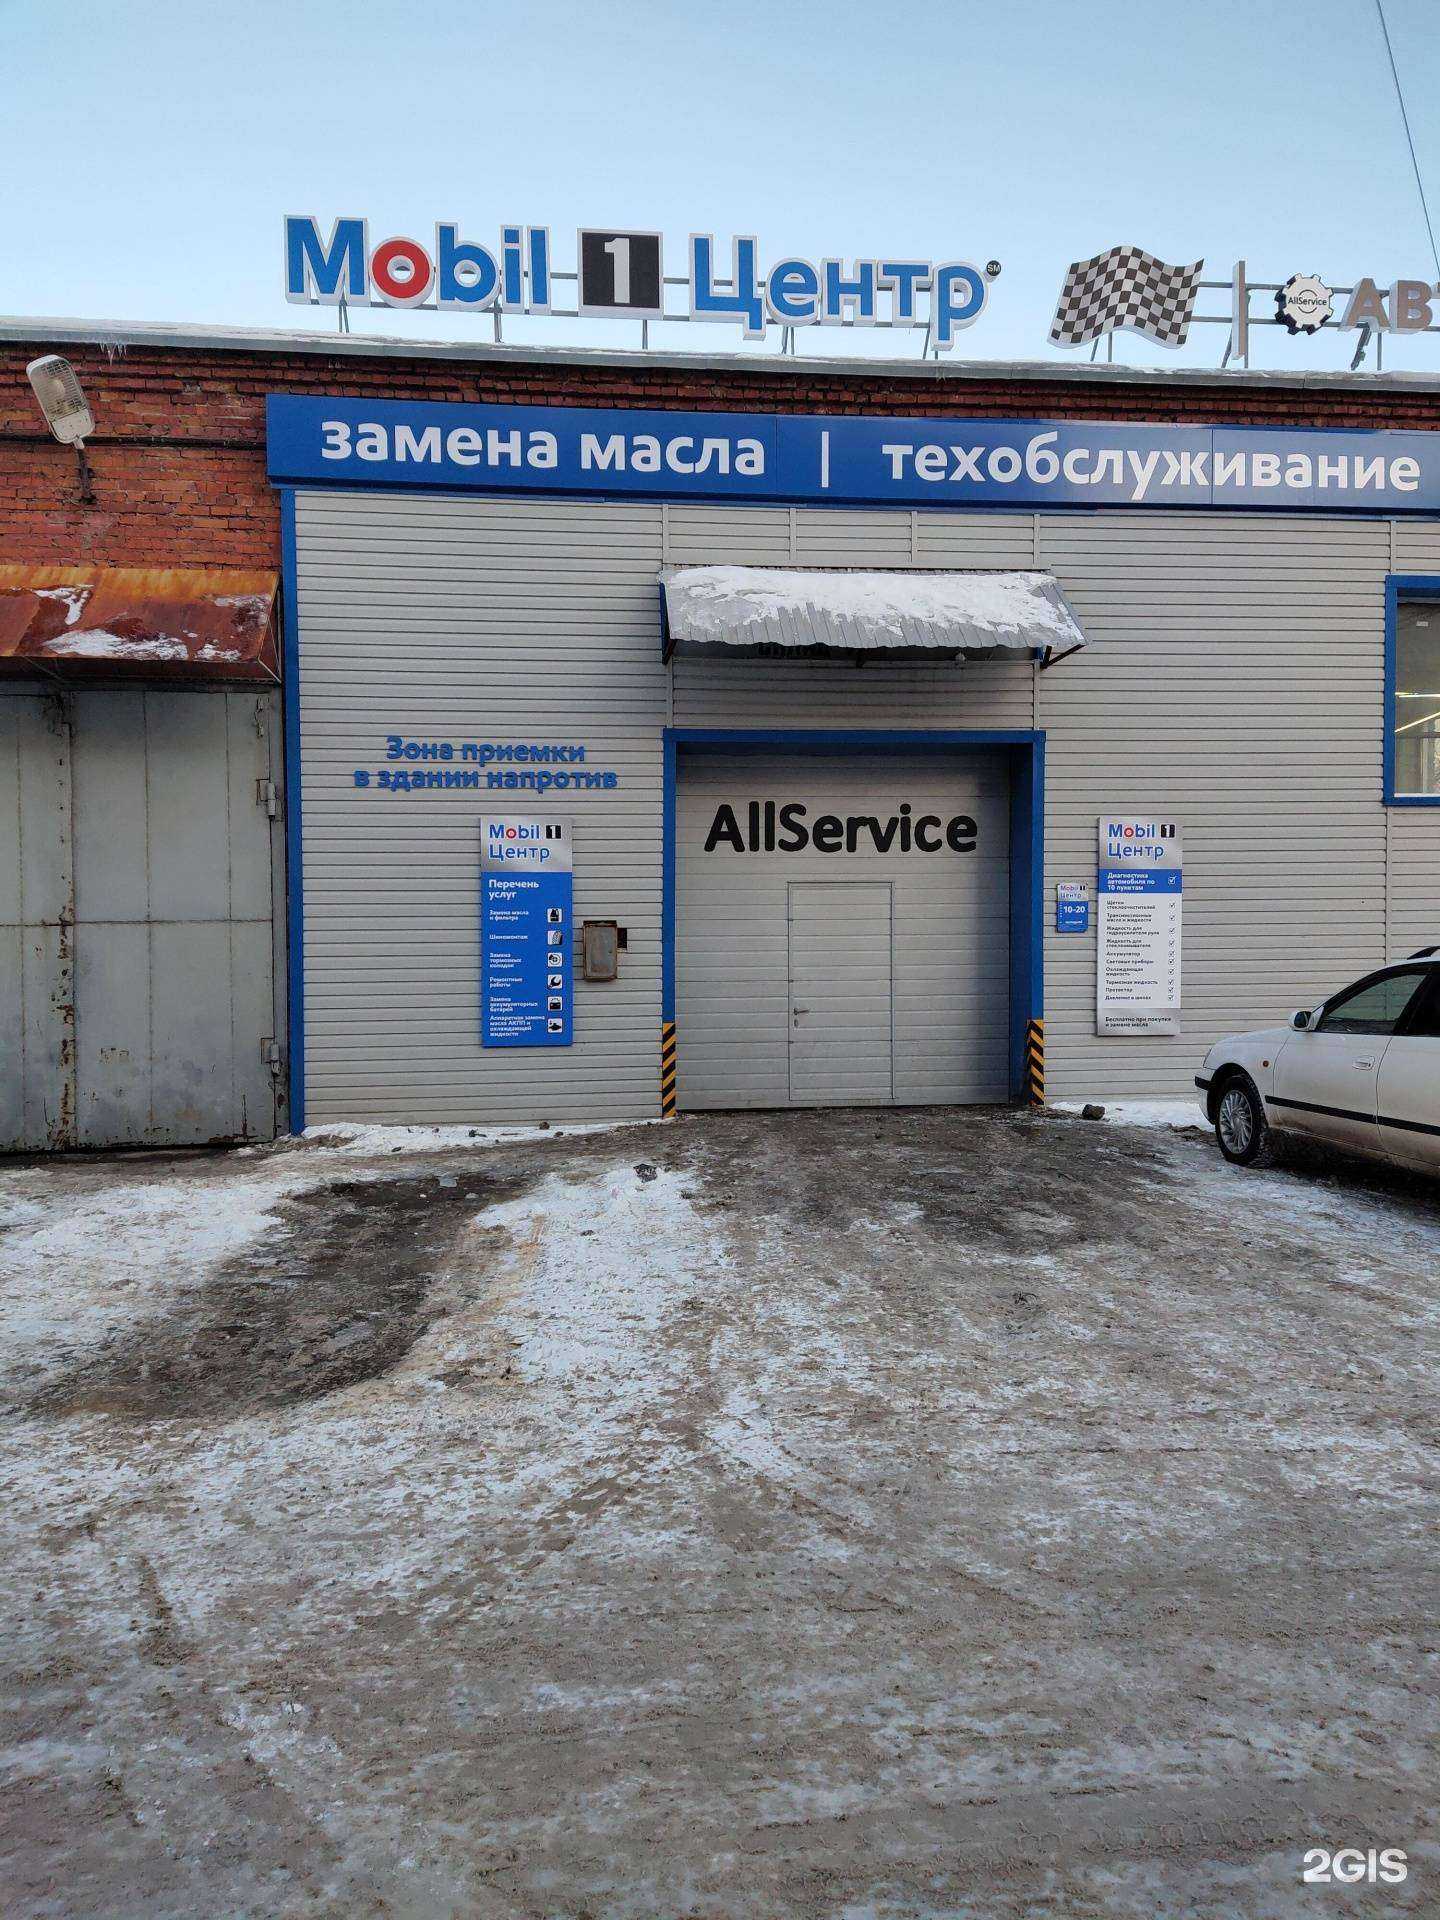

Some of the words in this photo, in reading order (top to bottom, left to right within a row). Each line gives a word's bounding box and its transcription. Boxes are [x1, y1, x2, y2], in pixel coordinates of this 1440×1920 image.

[284, 214, 551, 315] Mobil
[689, 233, 990, 350] Центр
[1288, 297, 1327, 306] AllService
[1338, 277, 1440, 334] АВ
[320, 420, 558, 468] замена
[581, 433, 764, 476] масла
[882, 431, 1421, 500] техобслуживание
[386, 736, 453, 760] Зона
[462, 742, 585, 767] приемки
[354, 770, 370, 787] в
[378, 771, 479, 792] здании
[487, 769, 618, 794] напротив
[489, 824, 540, 839] Mobil
[704, 801, 978, 852] AllService
[1108, 824, 1155, 838] Mobil
[489, 844, 550, 862] Центр
[1108, 843, 1164, 860] Центр
[488, 879, 540, 890] Перечень
[488, 891, 517, 901] услуг
